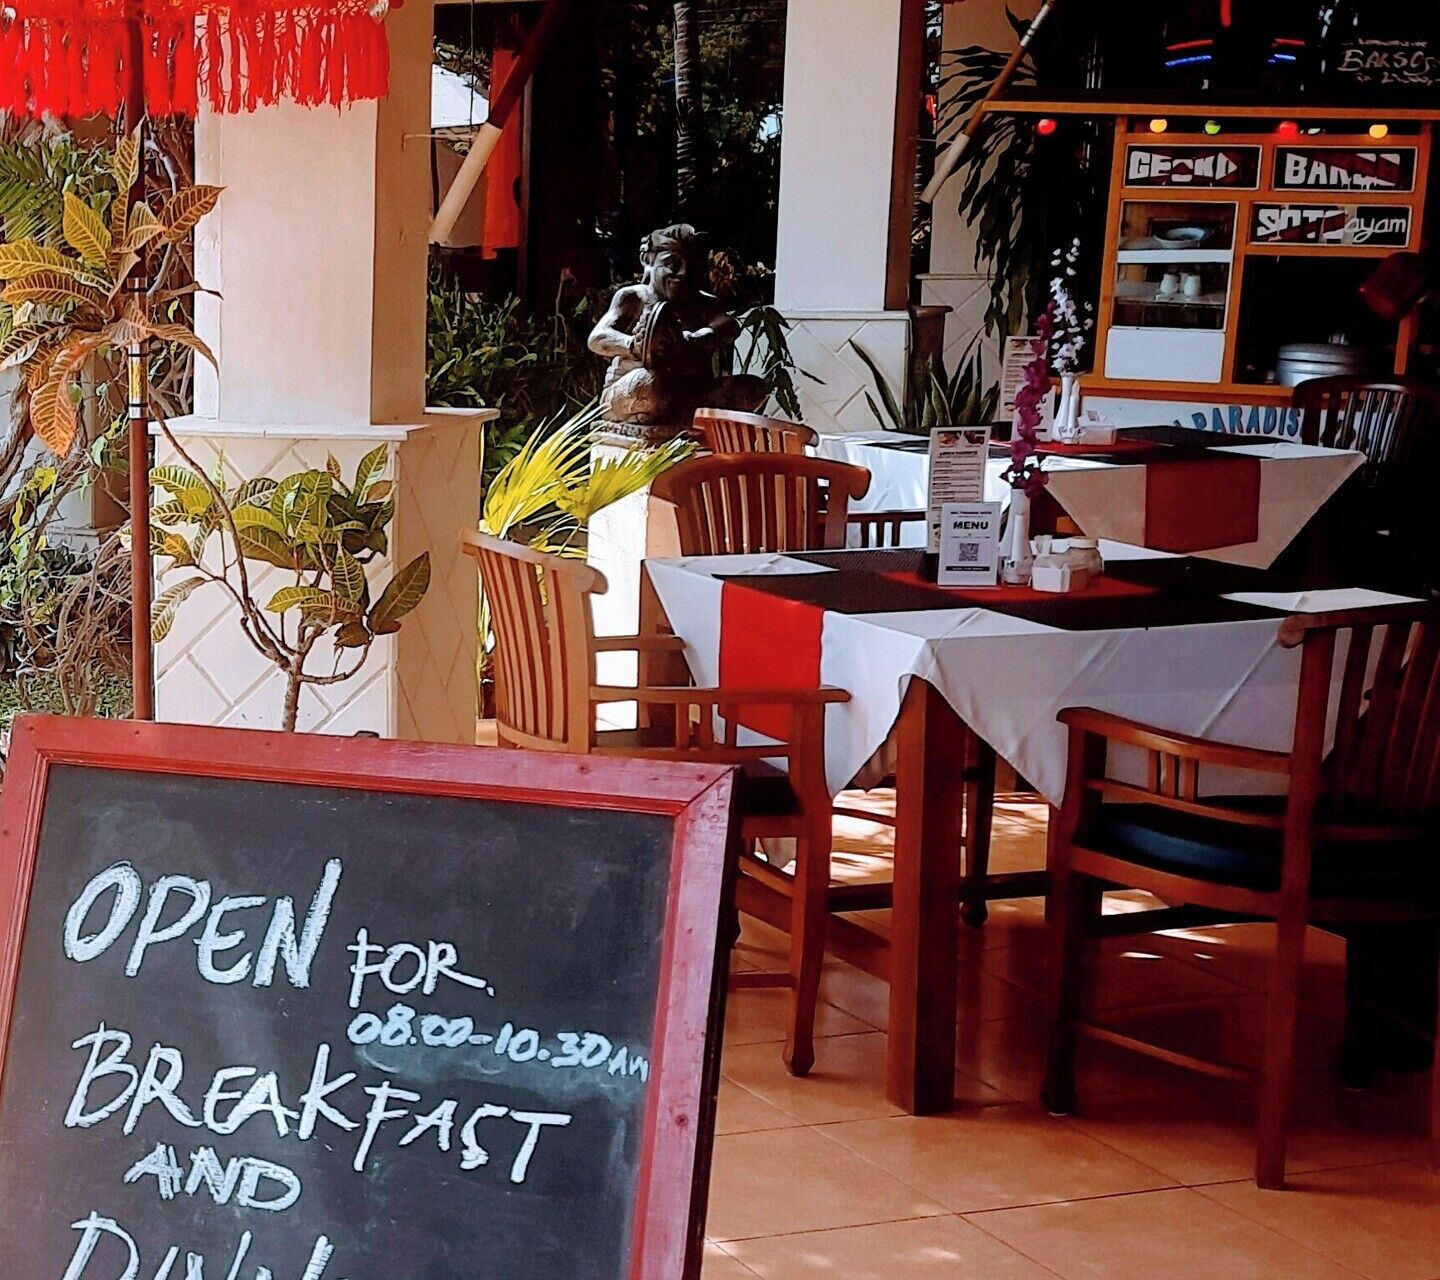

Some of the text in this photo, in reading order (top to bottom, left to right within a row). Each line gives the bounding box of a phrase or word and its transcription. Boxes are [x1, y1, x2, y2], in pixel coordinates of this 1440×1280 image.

[1345, 216, 1407, 243] ayam
[1191, 405, 1305, 438] PARADIS
[953, 521, 989, 530] MENU
[63, 857, 342, 988] OPEN
[64, 1021, 572, 1184] BREAKFAST
[122, 1142, 301, 1212] AND
